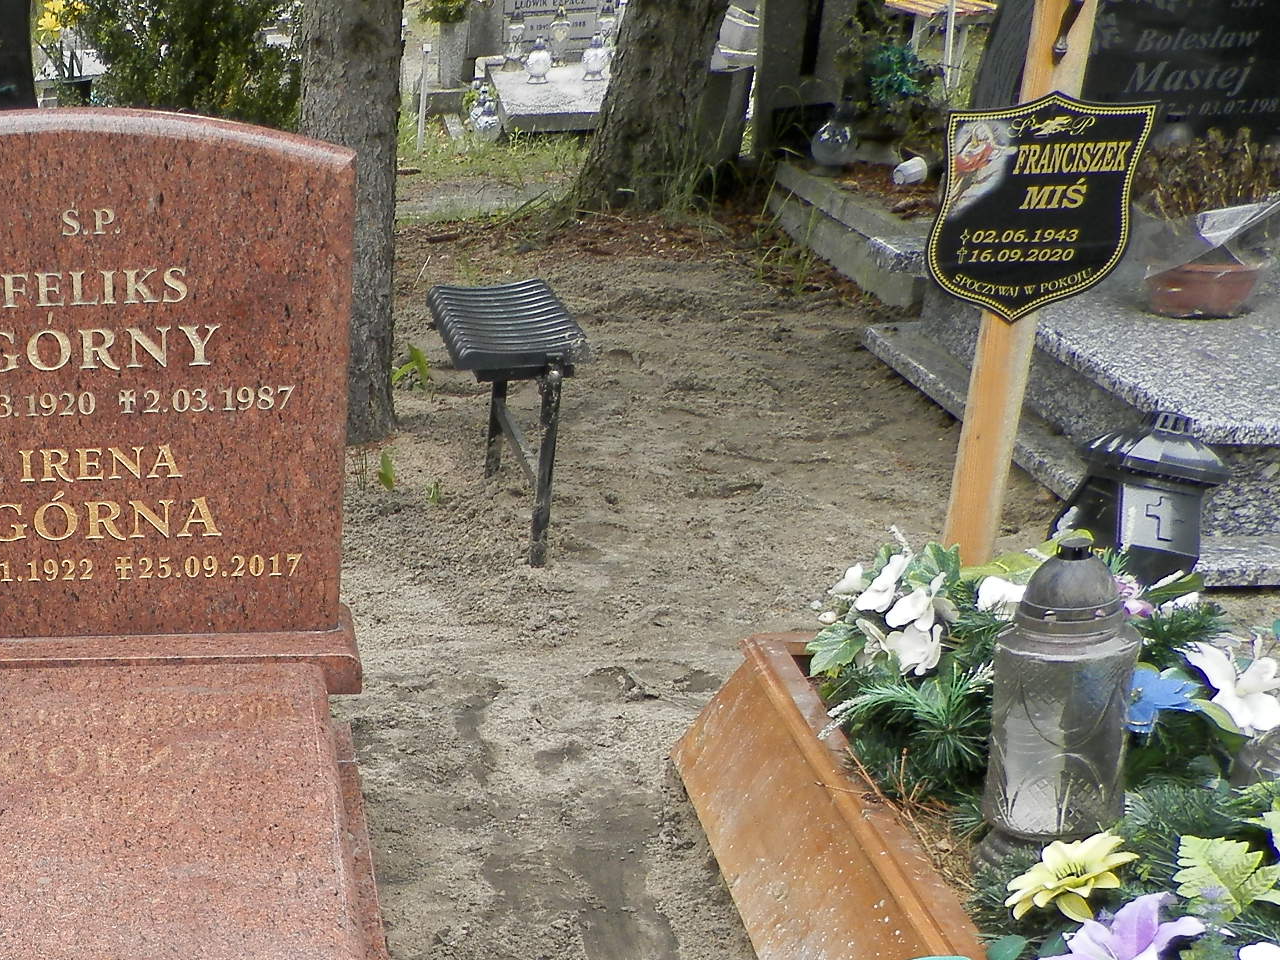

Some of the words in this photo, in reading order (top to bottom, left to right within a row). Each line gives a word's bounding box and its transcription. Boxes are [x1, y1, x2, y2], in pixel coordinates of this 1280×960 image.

[1012, 141, 1132, 175] FRANCISZEK
[1019, 177, 1088, 209] MIŚ
[61, 202, 122, 237] Ś.P.
[971, 228, 1080, 244] 02.06.1943
[968, 248, 1075, 264] 16.09.2020
[1, 267, 190, 309] FELIKS
[952, 273, 1020, 298] SPOCZYWAJ
[1023, 284, 1036, 296] W
[1039, 267, 1092, 293] POKOJU
[18, 443, 184, 483] IRENA
